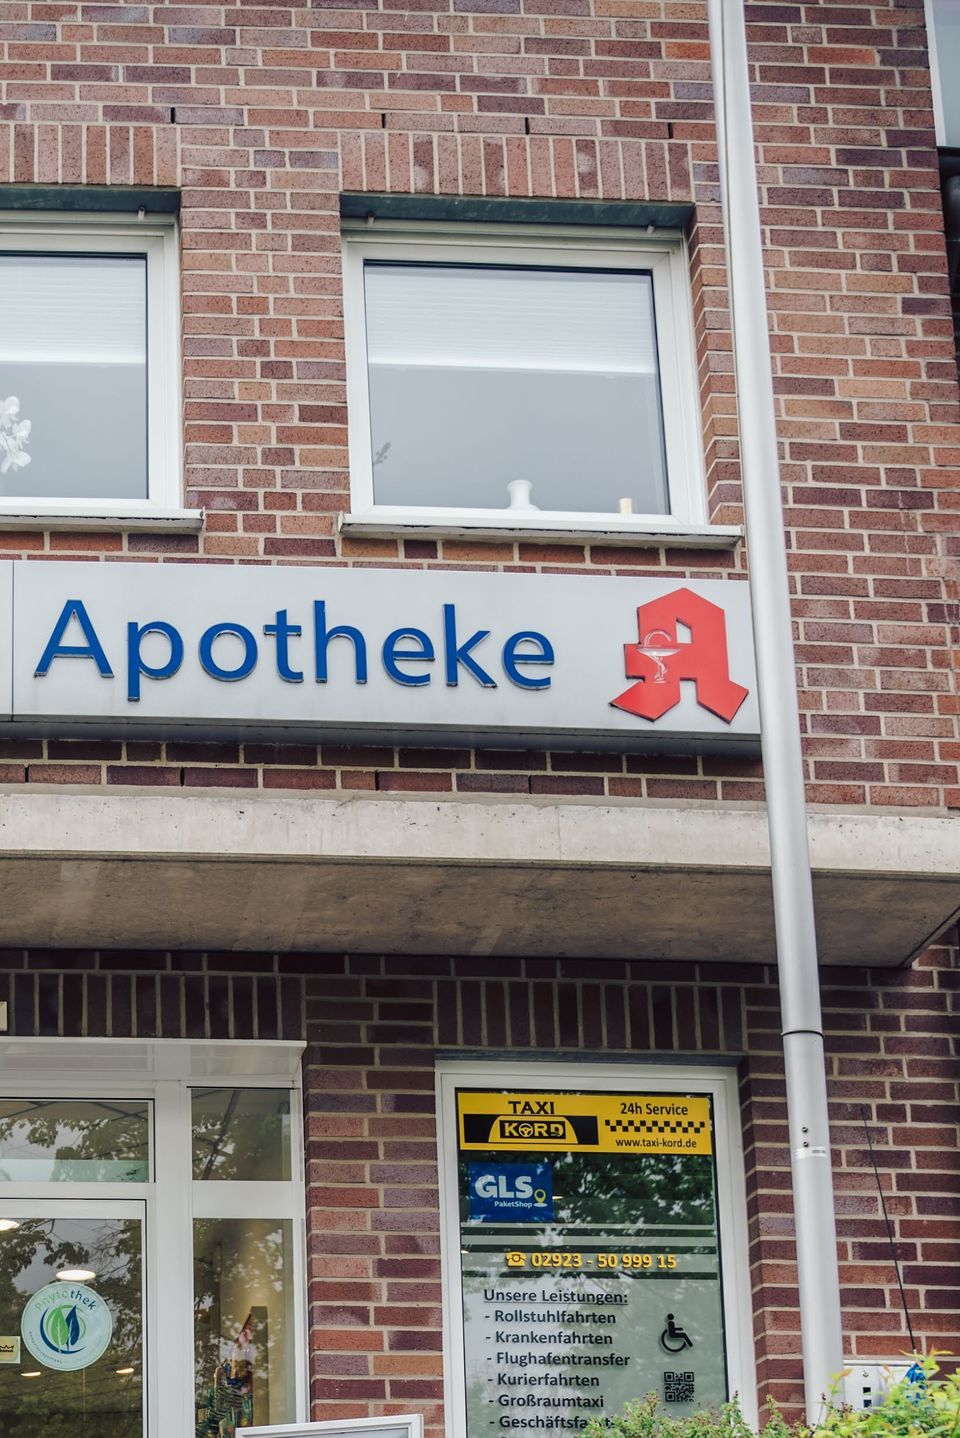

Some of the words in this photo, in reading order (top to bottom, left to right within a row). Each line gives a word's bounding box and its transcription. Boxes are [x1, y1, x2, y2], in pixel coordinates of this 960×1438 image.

[34, 599, 555, 702] Apotheke
[508, 1101, 554, 1115] TAXI
[620, 1103, 642, 1115] 24h
[646, 1103, 688, 1116] Service
[616, 1138, 697, 1149] www.taxi-kord.de
[474, 1175, 534, 1198] GLS
[494, 1200, 533, 1209] PaketShop
[531, 1254, 583, 1268] 02923
[597, 1254, 618, 1268] 50
[621, 1255, 653, 1269] 999
[657, 1255, 678, 1269] 15
[484, 1289, 537, 1302] Unsere
[542, 1290, 628, 1305] Leistungen:
[495, 1309, 616, 1324] Rollstuhlfahrten
[496, 1331, 613, 1345] Krankenfahrten
[496, 1352, 630, 1367] Flughafentransfer
[498, 1373, 600, 1386] Kurierfahrten
[498, 1394, 604, 1407] Großraumtaxi
